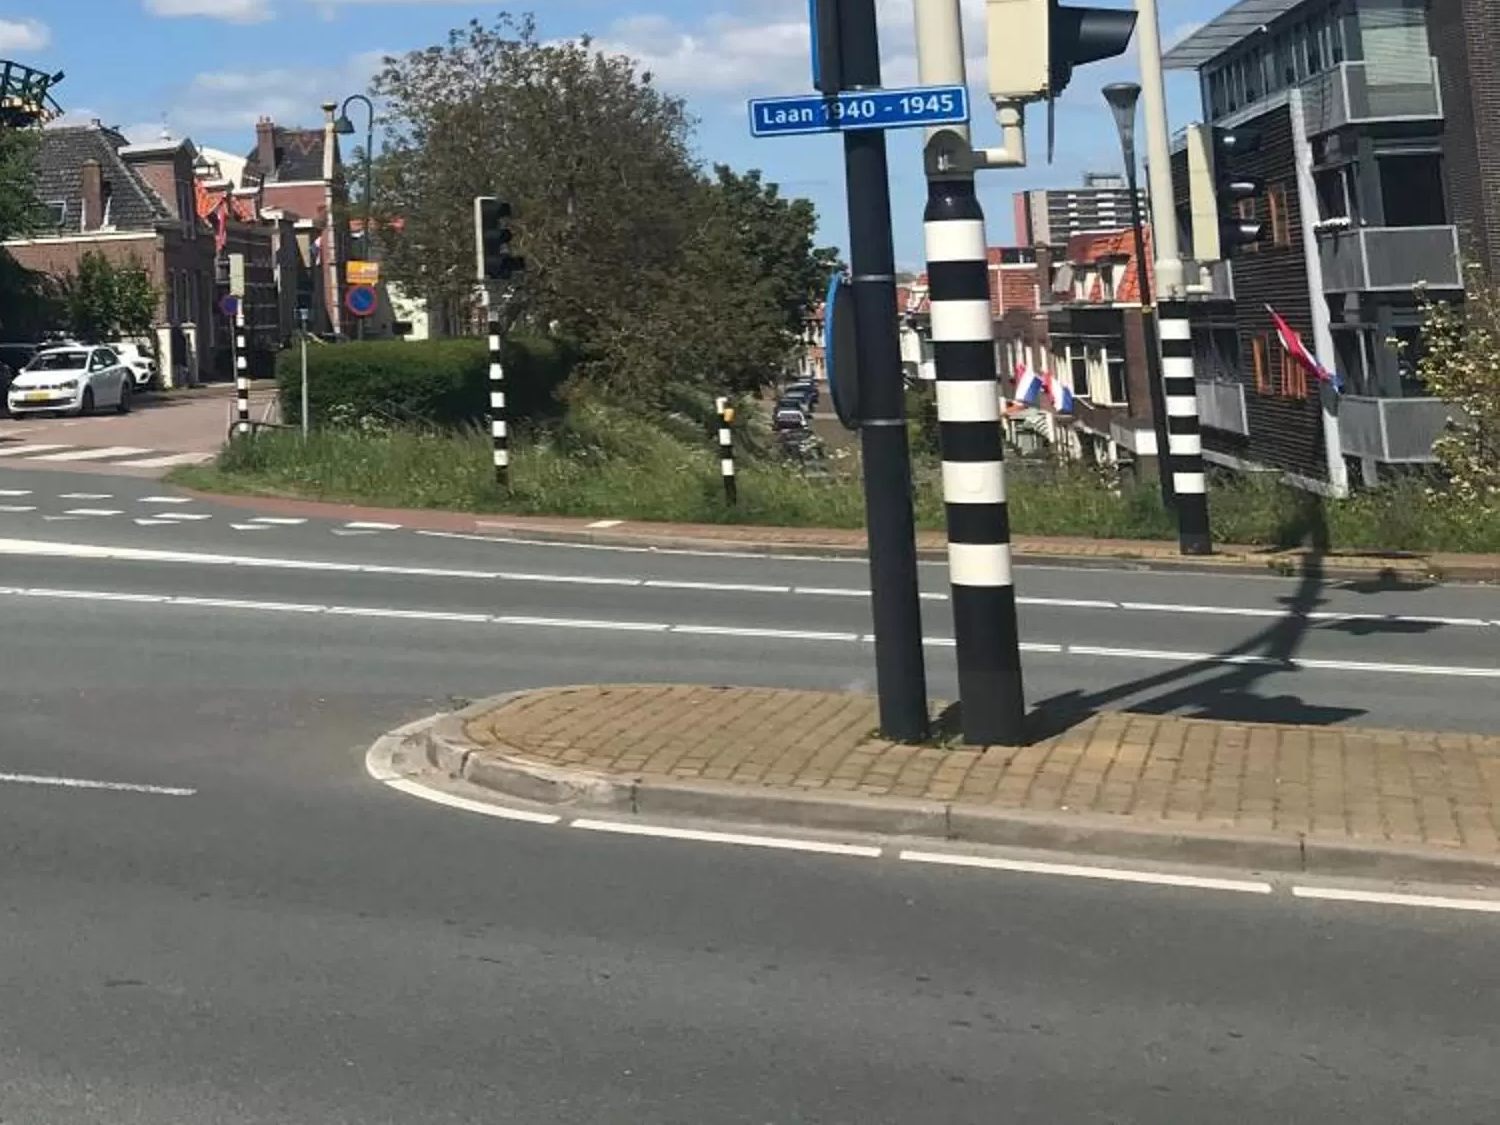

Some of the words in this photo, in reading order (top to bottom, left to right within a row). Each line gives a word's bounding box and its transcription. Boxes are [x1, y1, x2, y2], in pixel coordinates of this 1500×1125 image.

[763, 106, 813, 124] Laan
[820, 100, 875, 121] 1940
[900, 94, 954, 114] 1945
